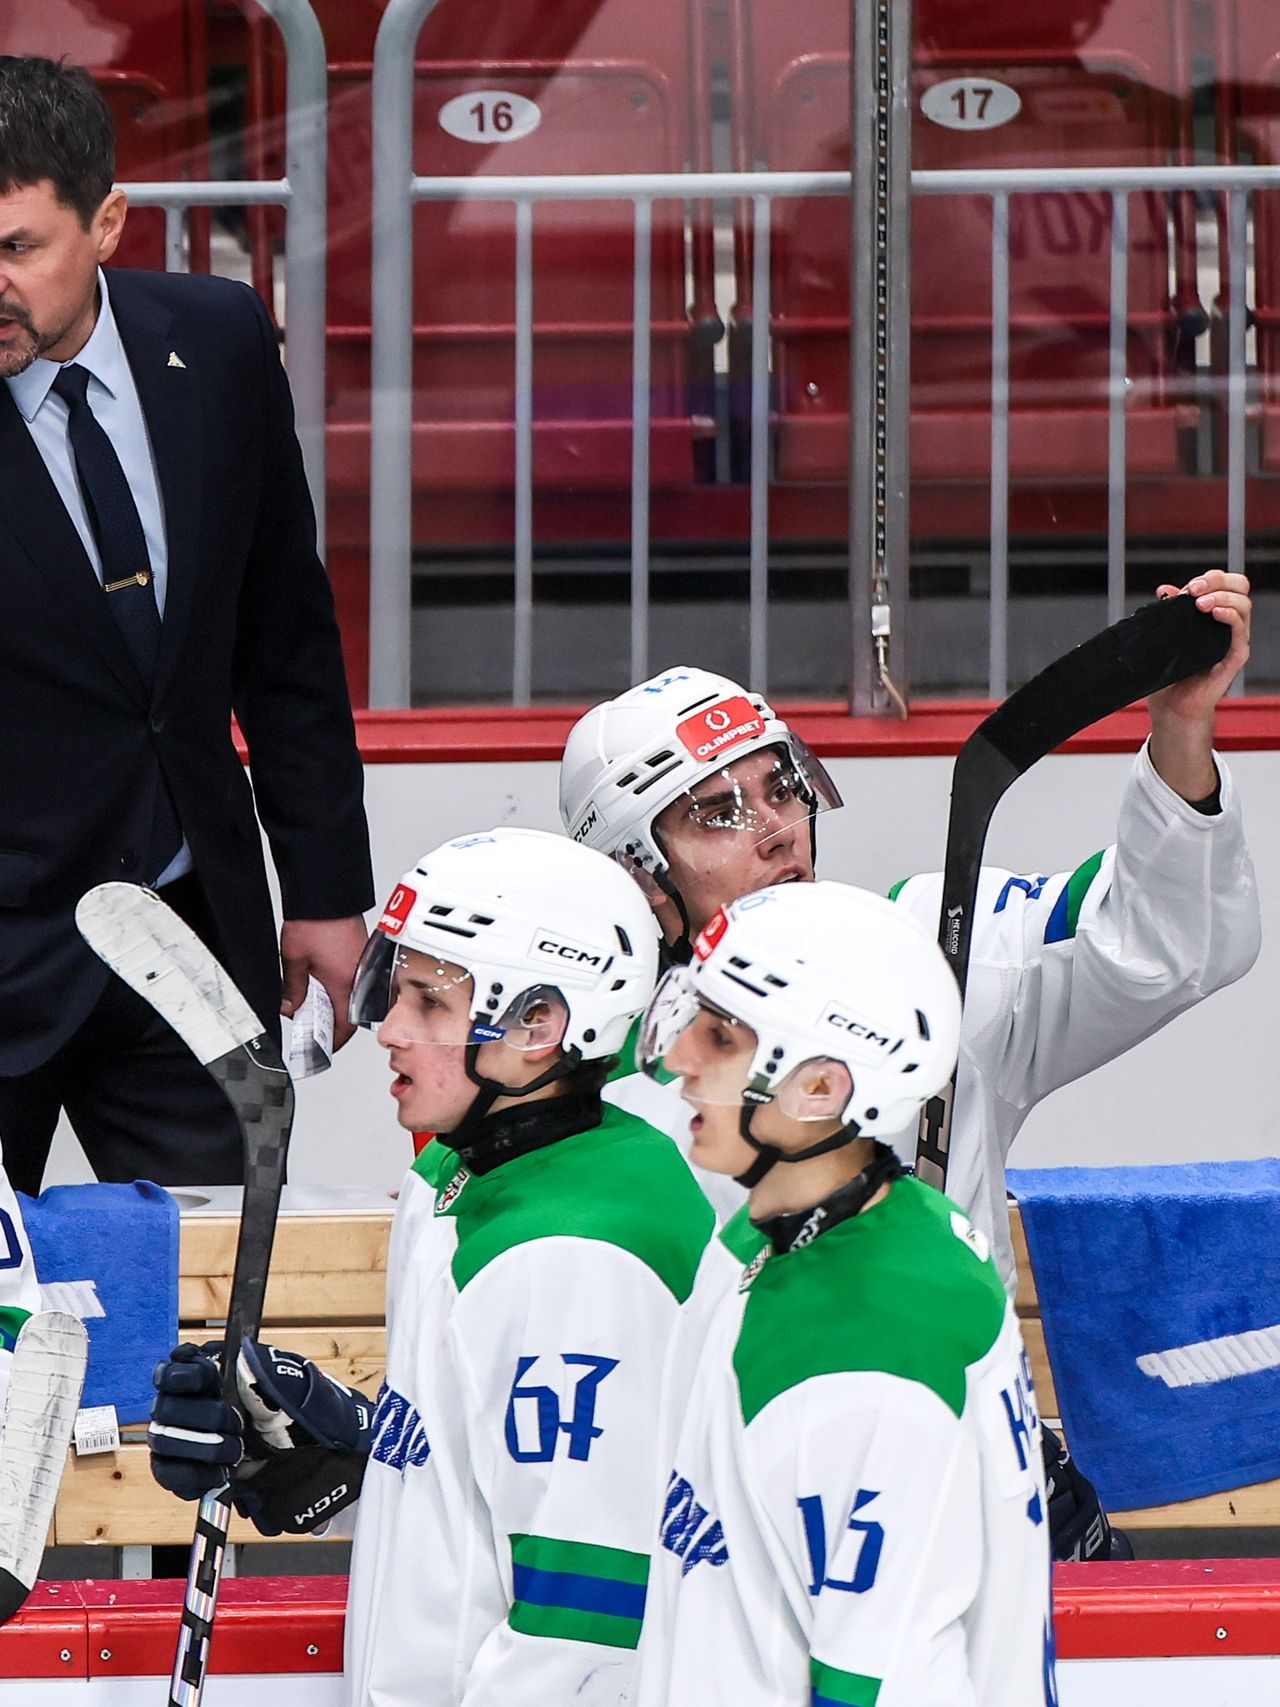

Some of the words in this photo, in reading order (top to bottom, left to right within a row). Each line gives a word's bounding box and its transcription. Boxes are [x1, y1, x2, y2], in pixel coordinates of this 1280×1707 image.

[469, 101, 513, 133] 16
[950, 87, 994, 120] 17
[696, 719, 761, 757] OLIMPBET
[537, 940, 602, 967] CCM
[474, 1027, 503, 1040] CCM
[827, 1013, 889, 1047] CCM
[276, 1364, 305, 1379] CCM
[505, 1352, 621, 1464] 67
[294, 1483, 348, 1526] CCM
